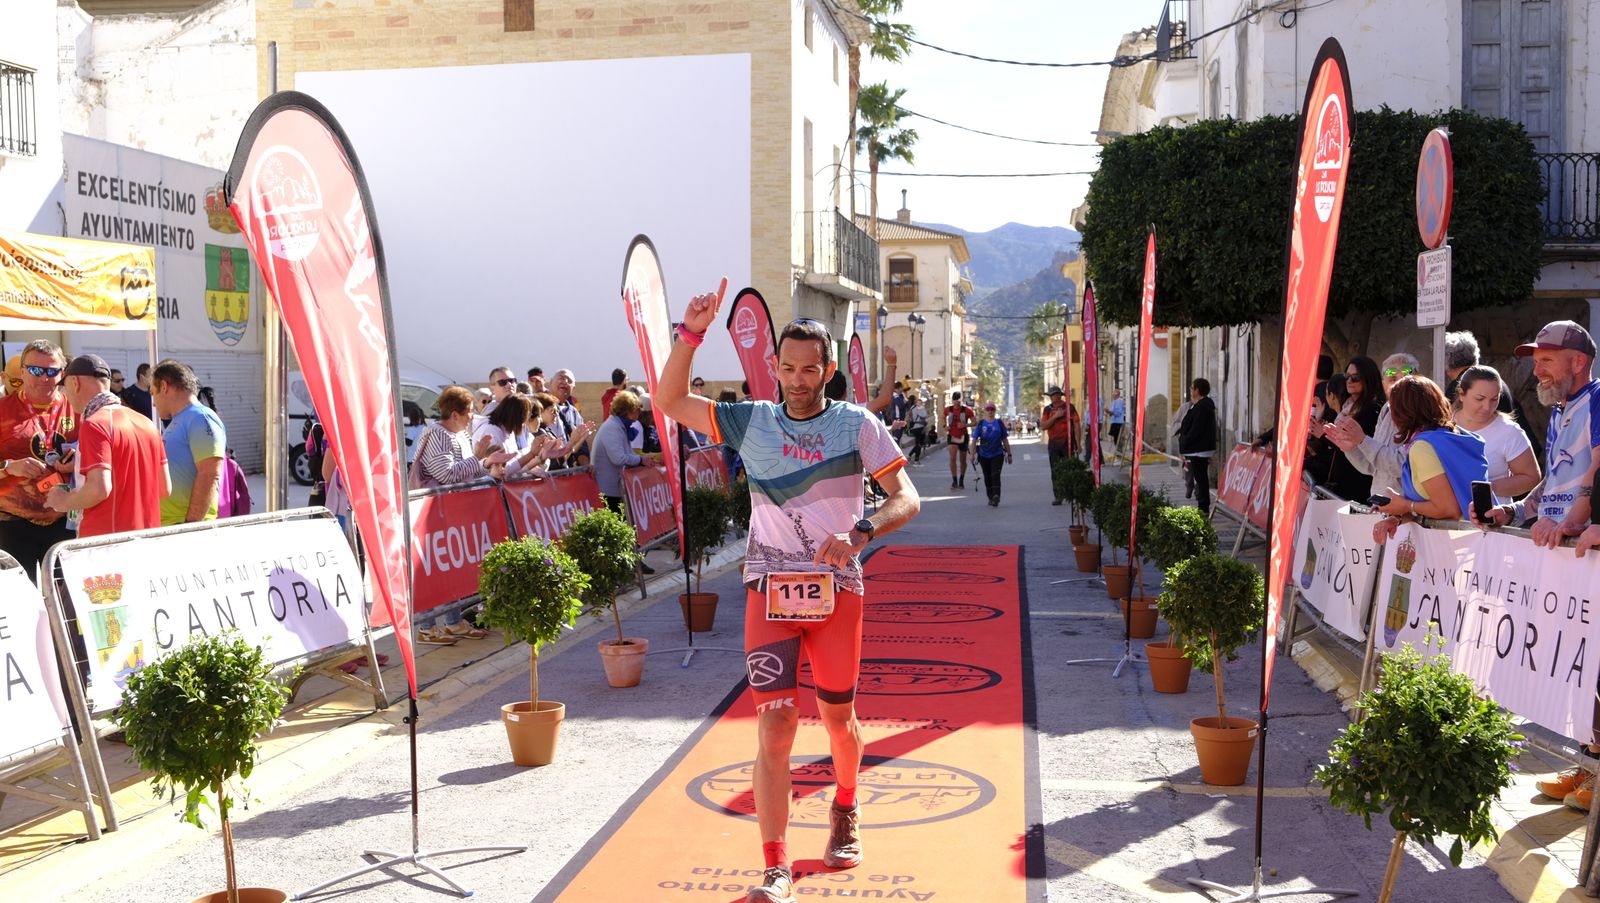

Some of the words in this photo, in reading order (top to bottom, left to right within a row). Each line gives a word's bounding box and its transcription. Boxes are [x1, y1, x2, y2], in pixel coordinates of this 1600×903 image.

[78, 171, 196, 215] EXCELENTÍSIMO
[81, 212, 195, 250] AYUNTAMIENTO
[783, 444, 824, 464] VIDA
[414, 521, 493, 577] VEOLIA
[1352, 548, 1372, 566] DE
[150, 554, 308, 598] AYUNTAMIENTO
[316, 550, 339, 568] DE
[779, 584, 820, 599] 112
[154, 573, 351, 649] CANTORIA
[1567, 595, 1590, 625] DE
[1410, 593, 1587, 688] CANTORIA
[916, 772, 957, 780] LA
[657, 880, 937, 902] Ayuntaiento
[867, 874, 916, 885] de
